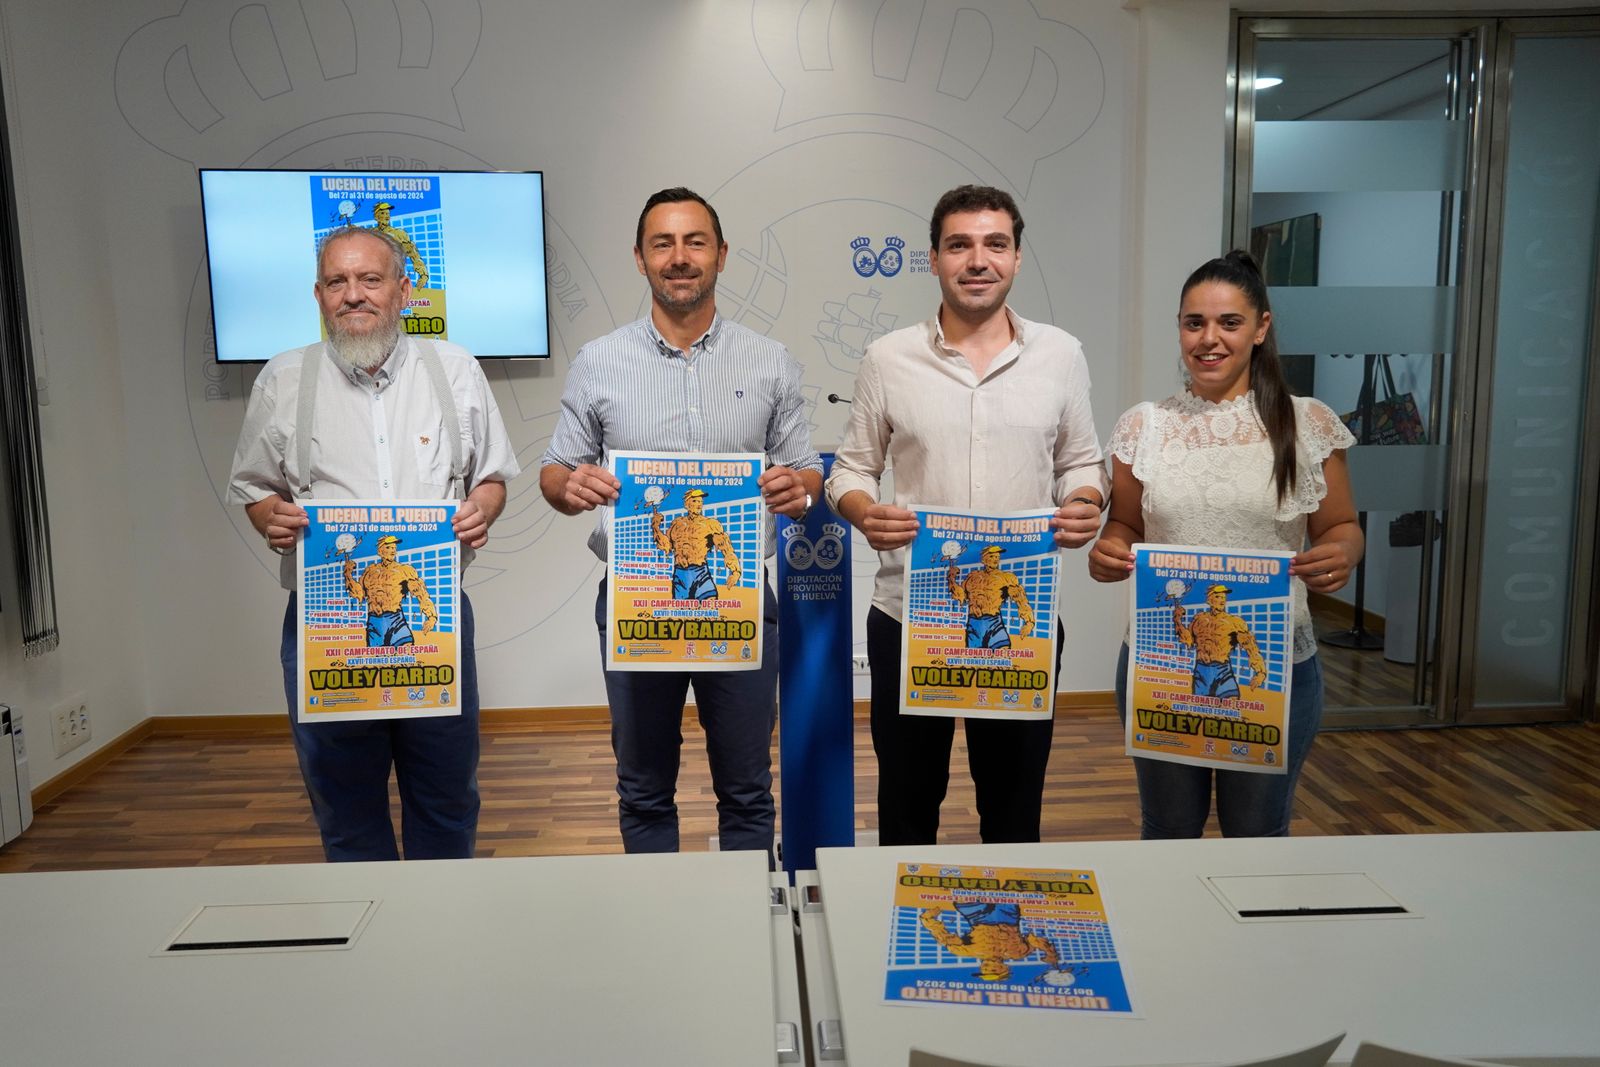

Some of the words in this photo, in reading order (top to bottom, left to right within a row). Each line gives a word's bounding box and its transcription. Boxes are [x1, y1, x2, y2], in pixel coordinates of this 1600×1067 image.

[322, 178, 365, 191] LUCENA
[366, 178, 386, 191] DEL
[388, 178, 431, 192] PUERTO
[374, 192, 397, 200] agosto
[627, 460, 676, 475] LUCENA
[678, 461, 701, 475] DEL
[703, 461, 752, 476] PUERTO
[635, 476, 646, 484] Del
[648, 476, 656, 484] 27
[658, 476, 665, 484] al
[667, 476, 675, 484] 31
[687, 477, 712, 486] agosto
[713, 477, 723, 485] de
[724, 477, 742, 485] 2024
[317, 508, 368, 522] LUCENA
[370, 508, 394, 522] DEL
[396, 508, 446, 522] PUERTO
[325, 524, 337, 532] Del
[380, 524, 405, 532] agosto
[407, 523, 416, 531] de
[418, 523, 437, 531] 2024
[927, 514, 974, 532] LUCENA
[976, 518, 999, 533] DEL
[1002, 517, 1049, 534] PUERTO
[933, 530, 944, 538] Del
[946, 531, 955, 539] 27
[956, 532, 963, 540] al
[974, 533, 983, 541] de
[985, 535, 1010, 543] agosto
[1012, 534, 1022, 542] de
[1023, 534, 1041, 542] 2024
[1150, 552, 1199, 569] LUCENA
[1201, 555, 1225, 571] DEL
[1227, 556, 1280, 574] PUERTO
[787, 574, 842, 583] DIPUTACIÓN
[1157, 568, 1169, 576] Del
[1170, 569, 1179, 577] 27
[1180, 570, 1188, 578] al
[1189, 570, 1198, 578] 31
[1199, 571, 1208, 579] de
[1210, 572, 1236, 582] agosto
[1238, 573, 1248, 582] de
[1249, 574, 1270, 583] 2024
[788, 583, 842, 592] PROVINCIAL
[714, 599, 741, 607] ESPAÑA
[802, 592, 836, 600] HUELVA
[618, 619, 683, 640] VOLEY
[684, 619, 755, 640] BARRO
[344, 647, 394, 655] CAMPEONATO
[410, 644, 437, 653] ESPAÑA
[1007, 648, 1034, 657] ESPAÑA
[389, 655, 415, 663] ESPAÑOL
[986, 657, 1011, 665] ESPAÑOL
[310, 667, 378, 691] VOLEY
[380, 664, 452, 688] BARRO
[910, 665, 975, 687] VOLEY
[976, 667, 1048, 690] BARRO
[1152, 690, 1166, 698] XXII
[1170, 692, 1219, 705] CAMPEONATO
[1222, 698, 1231, 706] DE
[1236, 699, 1265, 710] ESPAÑA
[1172, 702, 1188, 711] XXVII
[1190, 704, 1213, 714] TORNEO
[1214, 706, 1240, 717] ESPAÑOL
[1137, 708, 1203, 737] VOLEY
[1203, 716, 1280, 747] BARRO
[900, 874, 999, 890] BARRO
[1000, 878, 1093, 894] VOLEY
[915, 980, 945, 988] 2024
[965, 982, 1007, 990] agosto
[1009, 984, 1024, 992] de
[899, 986, 981, 1003] PUERTO
[984, 991, 1023, 1005] DEL
[1025, 993, 1109, 1009] LUCENA
